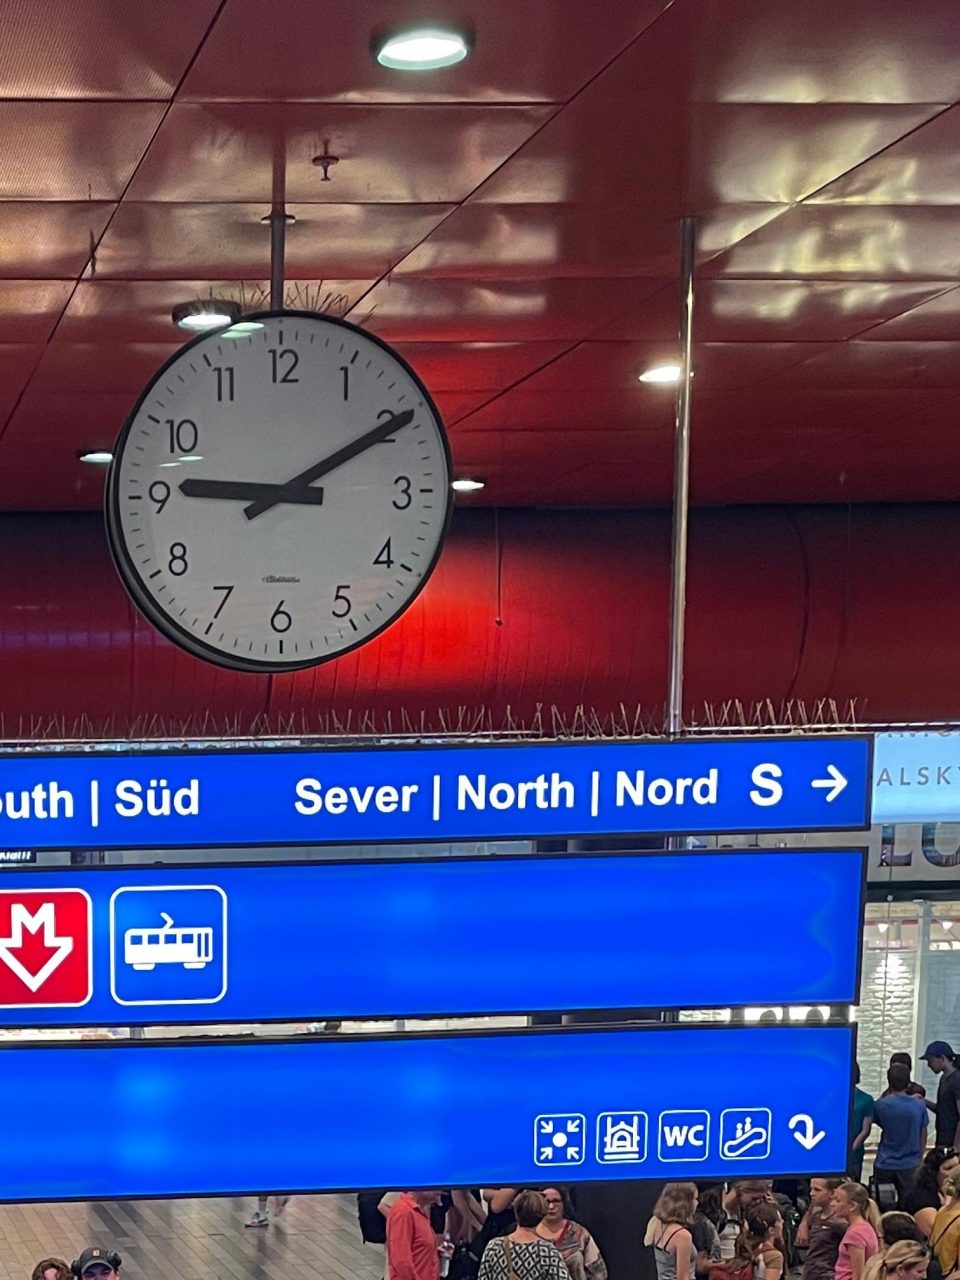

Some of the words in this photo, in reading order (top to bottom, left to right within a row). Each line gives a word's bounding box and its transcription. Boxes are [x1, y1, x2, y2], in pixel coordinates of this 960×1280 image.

[268, 349, 299, 384] 12
[340, 366, 349, 401] 1
[213, 367, 235, 402] 11
[166, 419, 198, 453] 10
[149, 480, 171, 514] 9
[392, 476, 412, 511] 3
[169, 542, 188, 576] 8
[372, 537, 394, 568] 4
[213, 585, 234, 619] 7
[271, 600, 292, 633] 6
[332, 585, 351, 618] 5
[114, 778, 200, 817] Süd
[294, 777, 419, 815] Sever
[457, 772, 575, 811] North
[615, 768, 718, 807] Nord
[749, 762, 783, 807] S
[876, 766, 960, 786] ALSK
[663, 1125, 704, 1147] WC
